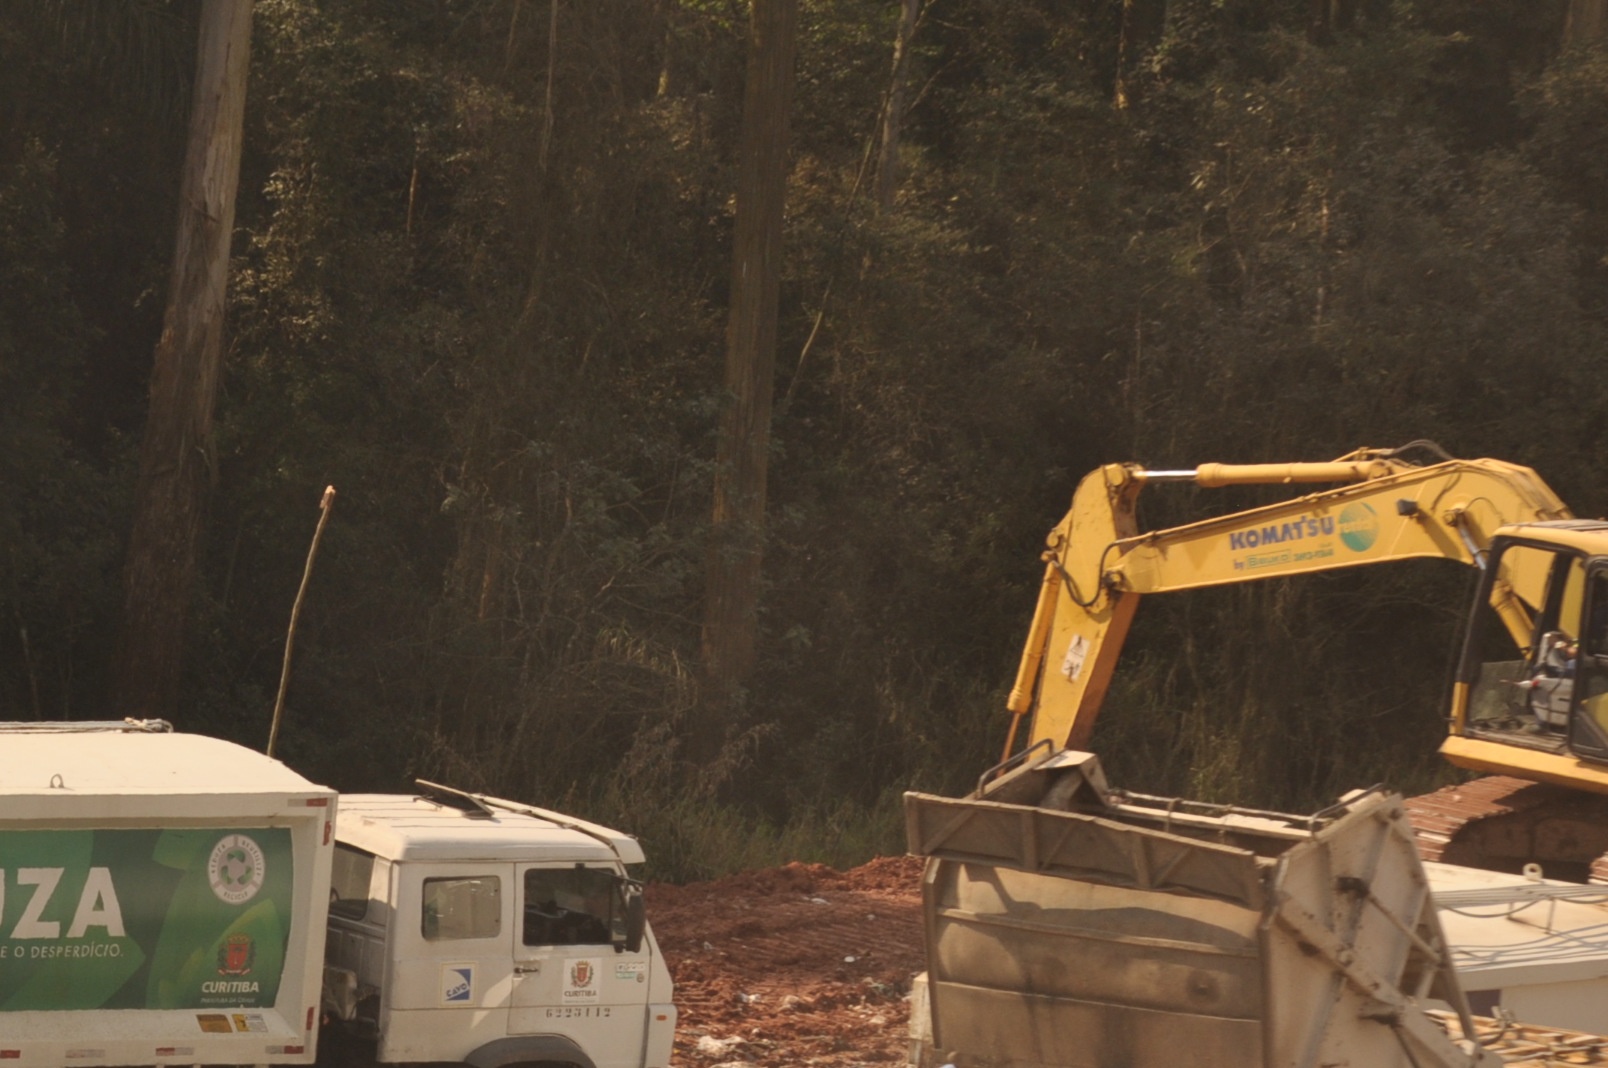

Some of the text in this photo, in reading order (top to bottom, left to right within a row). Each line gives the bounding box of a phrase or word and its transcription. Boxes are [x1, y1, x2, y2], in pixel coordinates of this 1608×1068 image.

[1229, 516, 1334, 550] KOMATSU
[14, 946, 25, 959] O
[30, 941, 125, 959] DESPERDÍCIO.
[201, 981, 260, 994] CURITIBA
[446, 982, 468, 998] CAVO
[546, 1007, 611, 1018] 6223112
